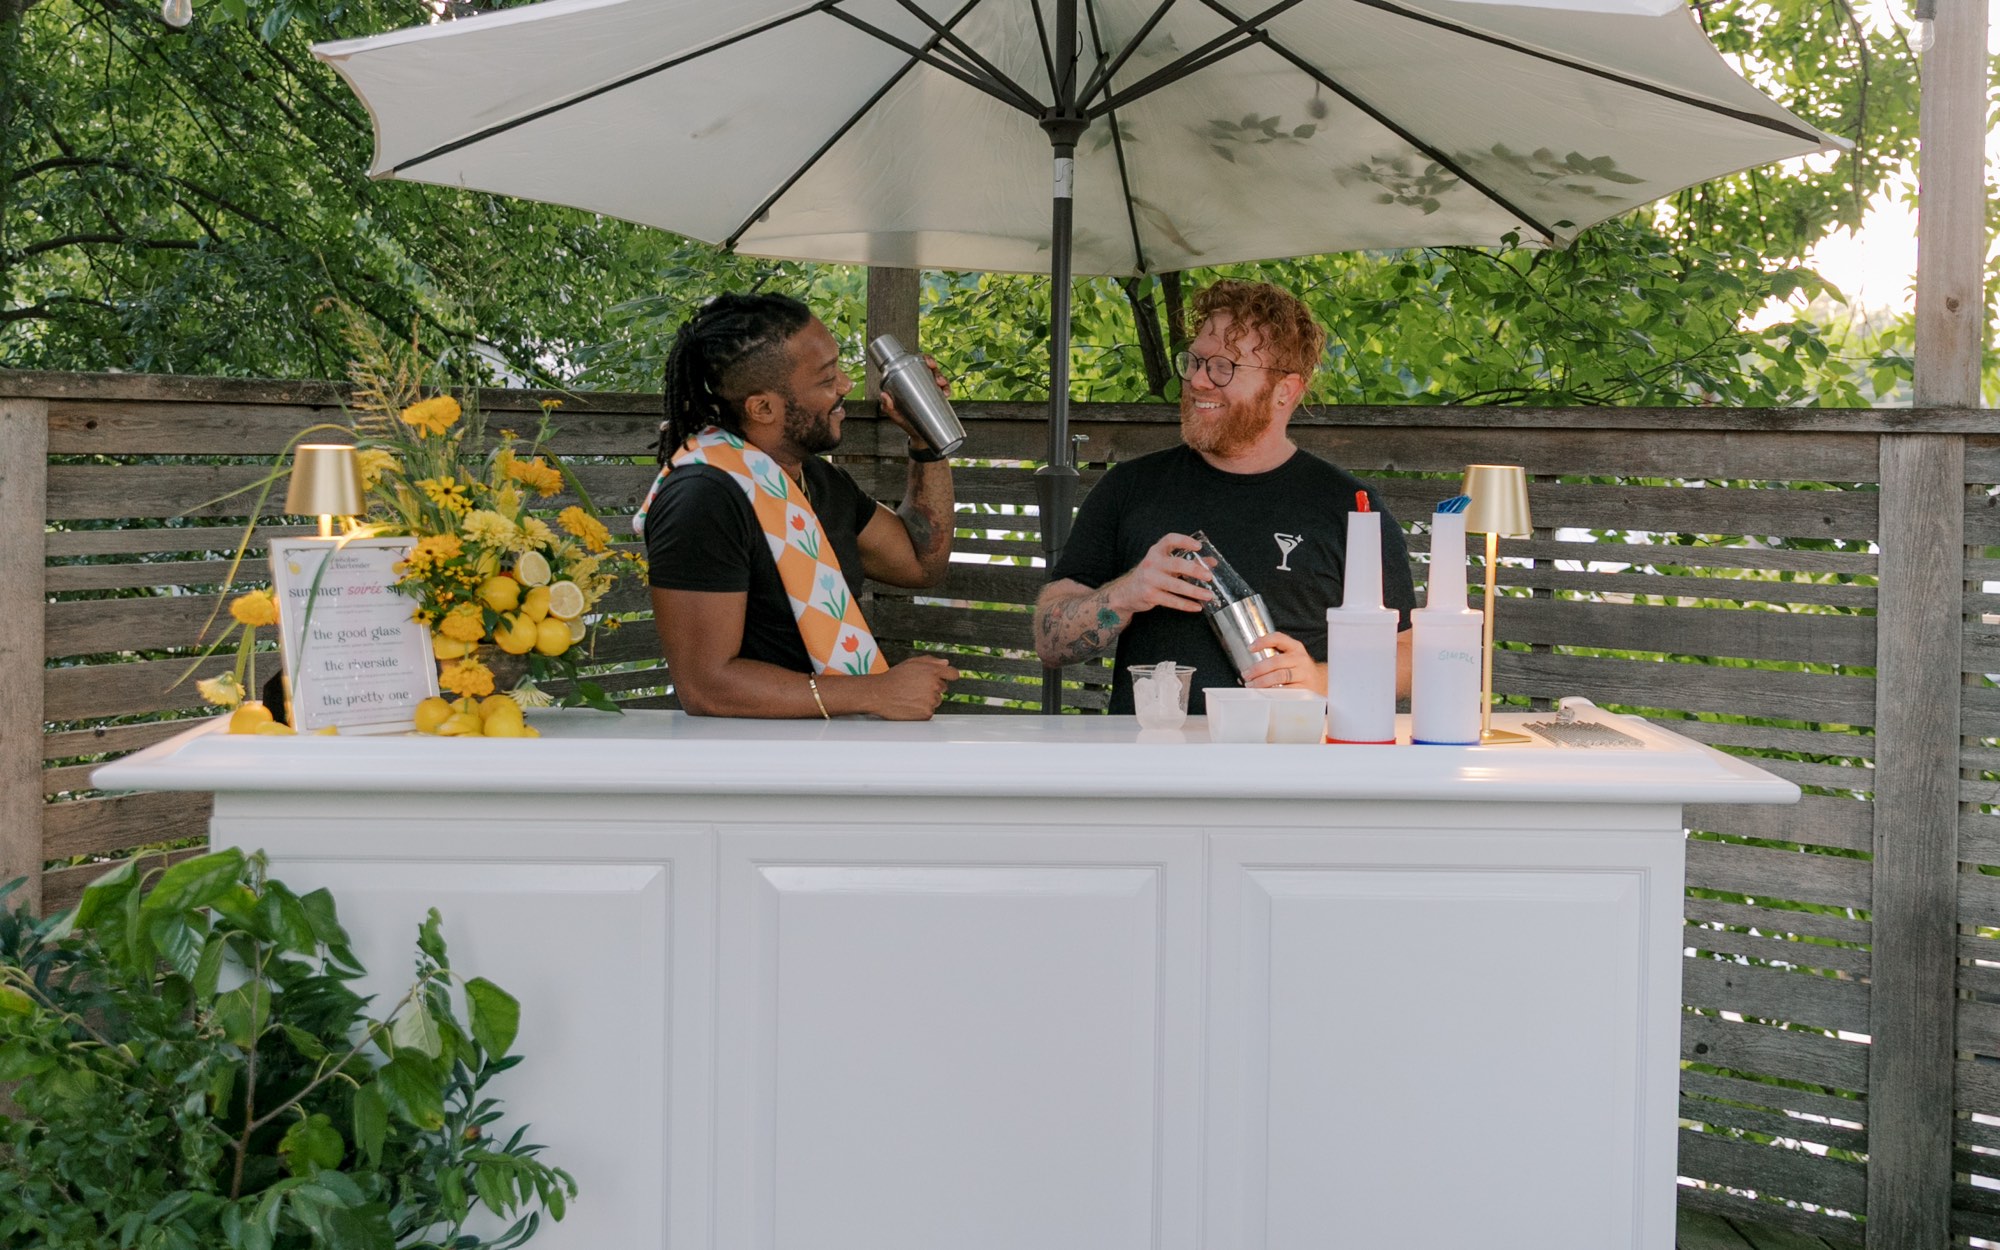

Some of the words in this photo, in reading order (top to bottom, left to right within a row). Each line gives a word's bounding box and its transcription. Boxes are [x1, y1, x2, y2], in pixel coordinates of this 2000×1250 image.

[313, 629, 333, 640] the
[337, 627, 367, 643] good
[371, 626, 402, 641] glass
[325, 660, 344, 671] the
[348, 657, 399, 670] riverside
[323, 695, 343, 706] the
[346, 691, 385, 707] pretty
[388, 691, 409, 701] one
